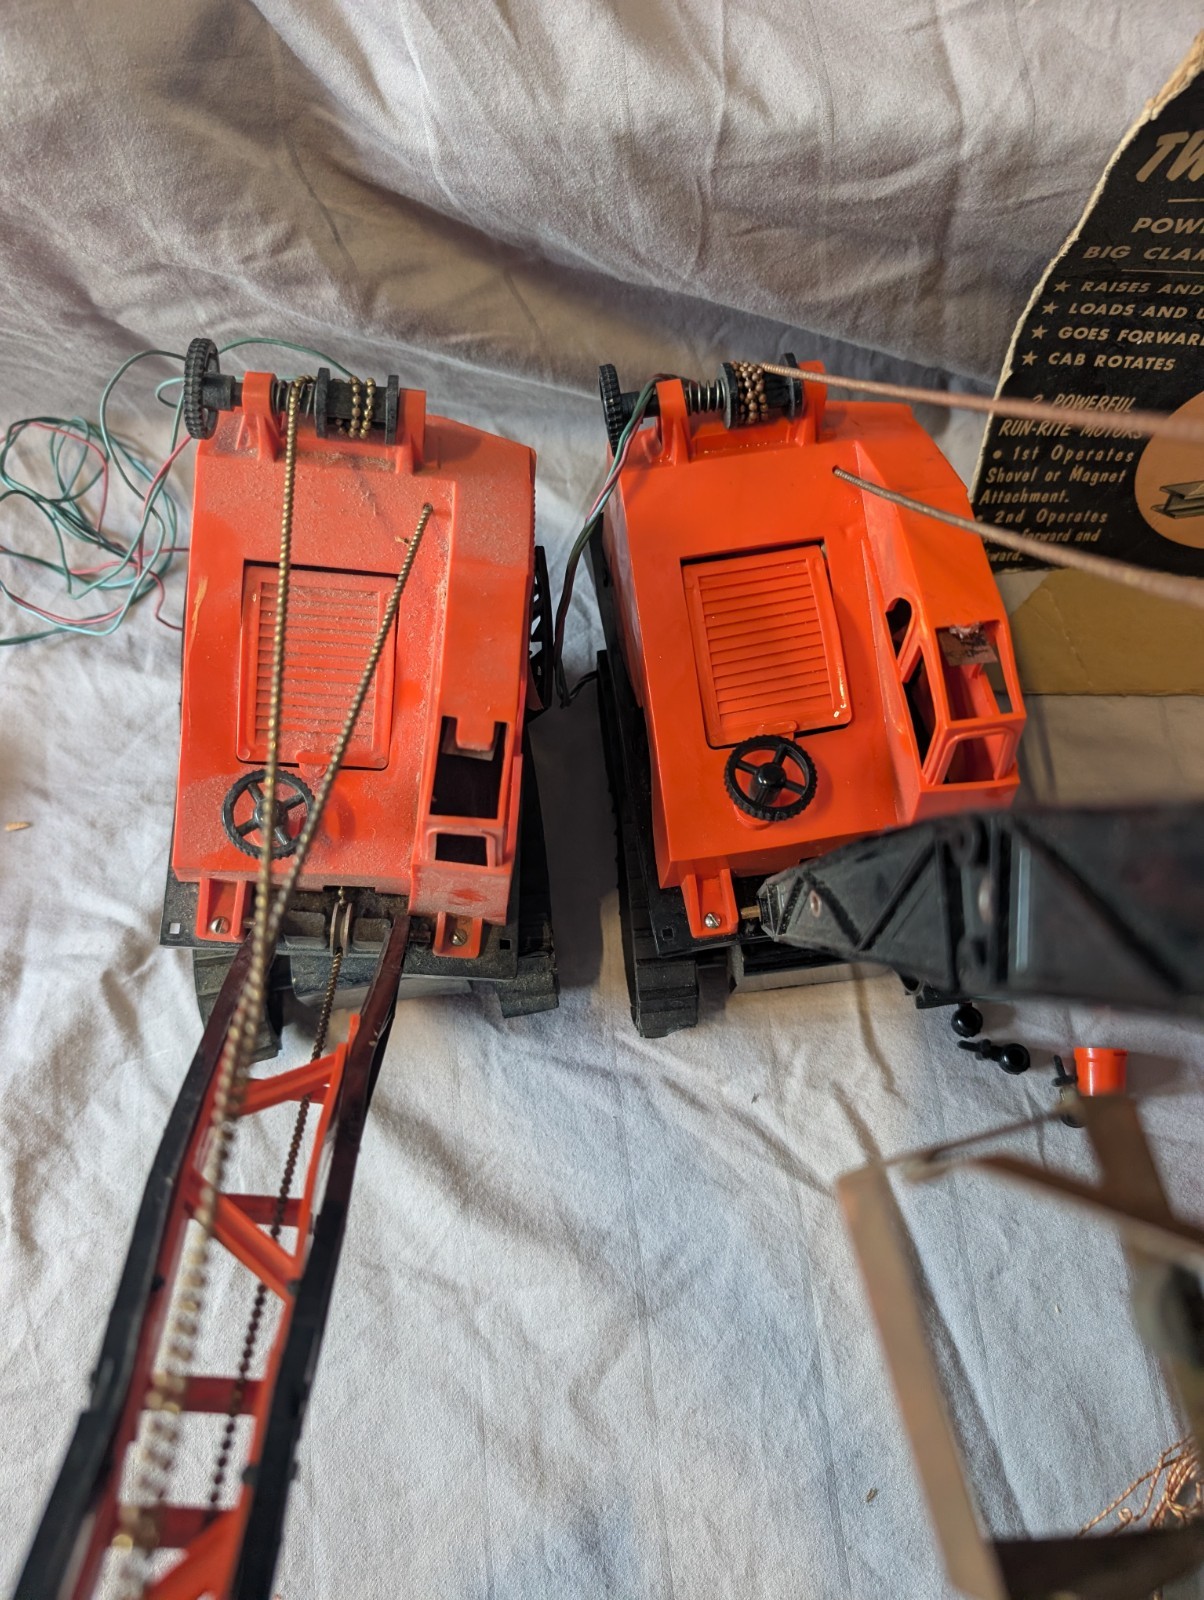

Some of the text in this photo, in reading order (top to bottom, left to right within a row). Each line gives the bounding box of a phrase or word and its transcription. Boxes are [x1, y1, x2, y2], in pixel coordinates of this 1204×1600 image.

[1082, 245, 1132, 259] BIG
[1080, 281, 1204, 295] RAISES AND
[1068, 303, 1136, 316] LOADS
[1141, 305, 1188, 319] AND
[1057, 326, 1111, 341] GOES
[1047, 352, 1177, 371] CAB ROTATES
[1051, 393, 1137, 413] POWERFUL
[998, 419, 1072, 437] RUN-RITE
[1012, 444, 1135, 465] 1st Operates
[985, 464, 1128, 487] Shovel or Magnet
[978, 487, 1070, 506] Attachment.
[994, 508, 1109, 527] 2nd Operates
[1074, 528, 1102, 543] and
